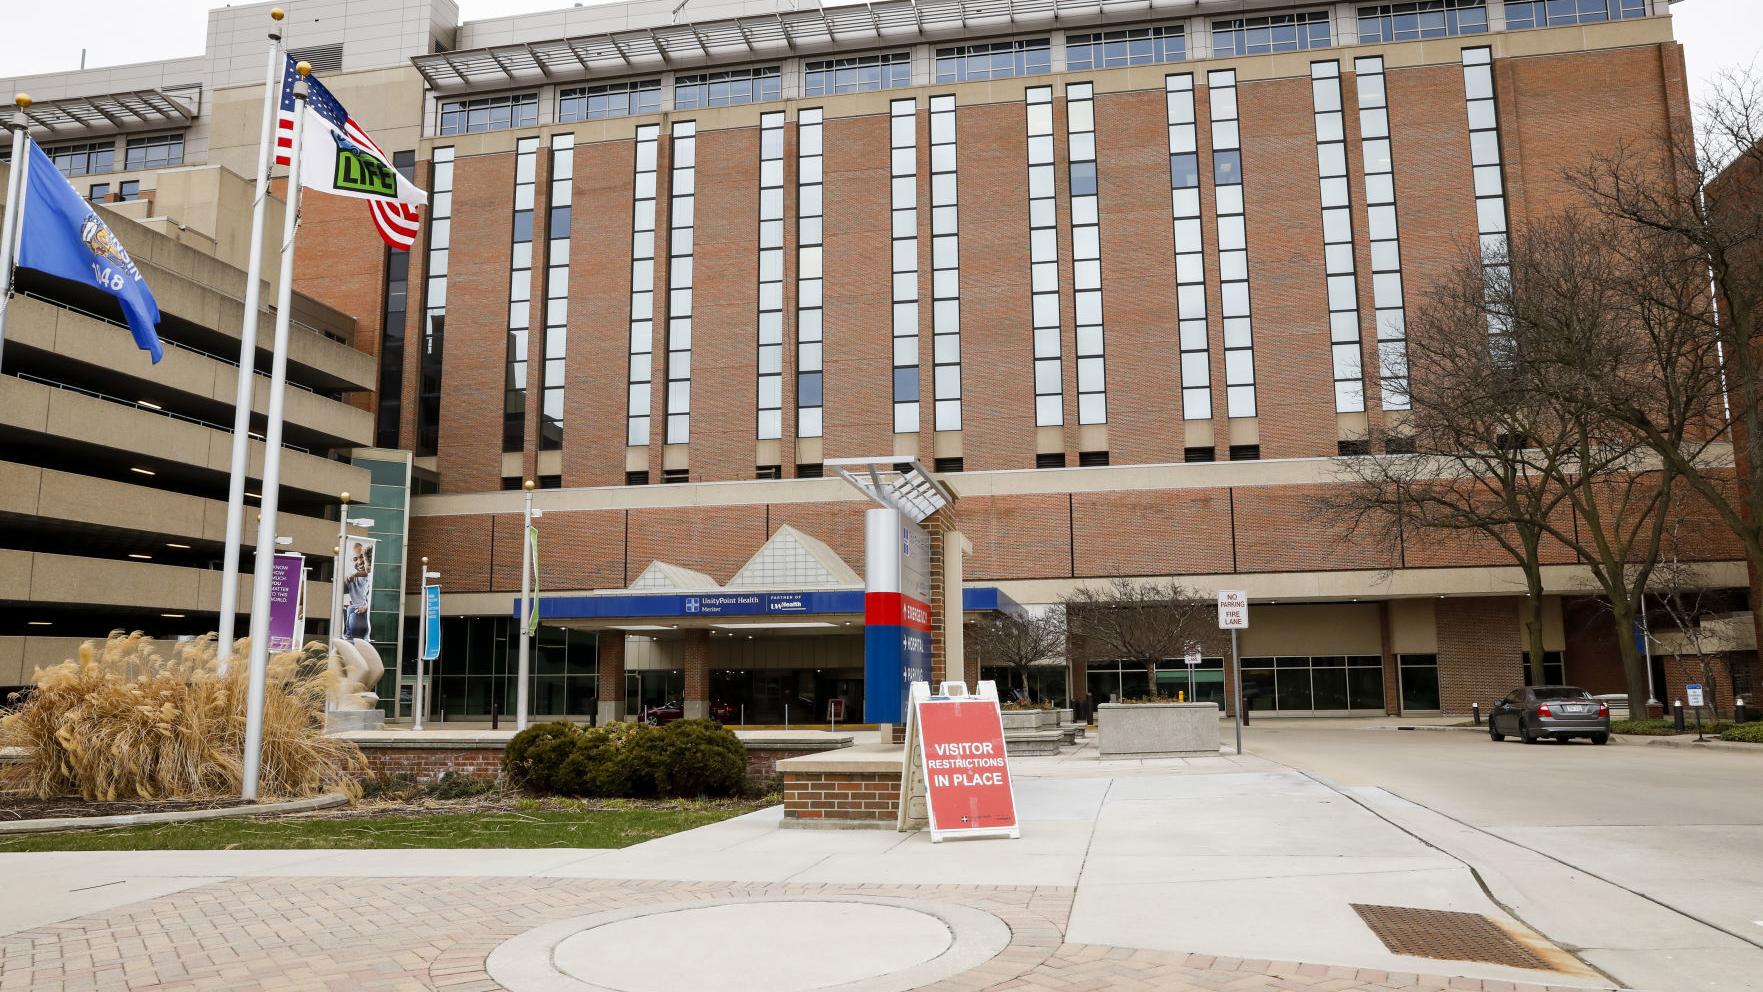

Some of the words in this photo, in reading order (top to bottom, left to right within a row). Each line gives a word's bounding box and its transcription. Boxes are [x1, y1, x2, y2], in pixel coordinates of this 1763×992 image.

[343, 155, 392, 189] LIFE
[92, 262, 124, 290] 148
[702, 597, 736, 605] UnityPoint
[737, 596, 759, 604] Health
[907, 604, 928, 624] EMERGENCY
[907, 636, 924, 653] HOSPITAL
[934, 742, 994, 756] VISITOR
[928, 757, 1004, 769] RESTRICTIONS
[934, 774, 950, 787] IN
[953, 772, 1003, 786] PLACE
